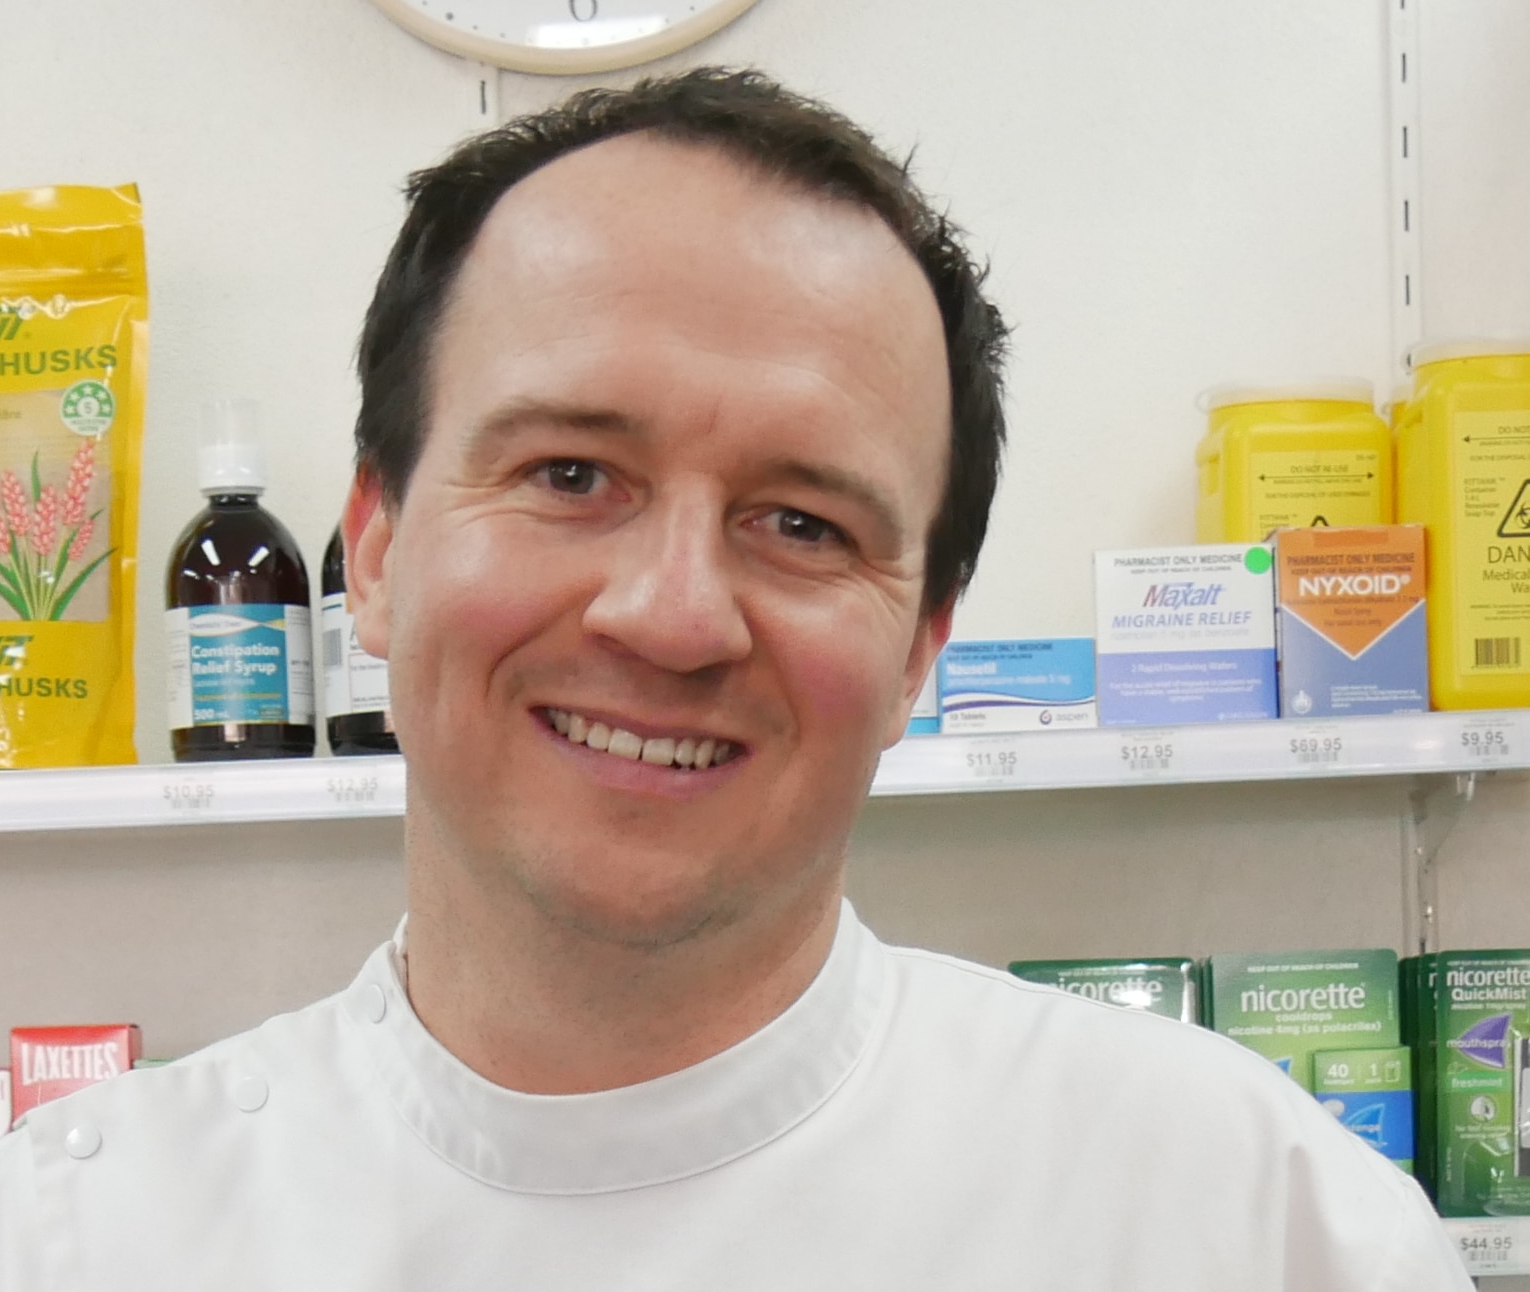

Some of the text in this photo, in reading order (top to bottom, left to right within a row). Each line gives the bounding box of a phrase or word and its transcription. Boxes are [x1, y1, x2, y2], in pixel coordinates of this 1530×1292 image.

[1114, 554, 1242, 567] PHARMACIST ONLY MEDICINE
[1287, 552, 1415, 566] PHARMACIST ONLY MEDICINE
[1483, 568, 1530, 582] Medical
[1298, 574, 1401, 597] NYXOID
[1143, 582, 1223, 610] Maxalt
[1112, 611, 1252, 629] MIGRAINE RELIEF
[191, 643, 280, 659] Constipation
[191, 660, 277, 676] Relief Syrup
[1290, 738, 1343, 754] $69.95
[1461, 731, 1504, 747] $9.95
[966, 752, 1018, 768] $11.95
[1121, 744, 1173, 760] $12.95
[1241, 982, 1366, 1013] nicorette
[1451, 987, 1527, 1002] QuickMist
[1275, 1011, 1332, 1023] cooldrops
[1228, 1024, 1272, 1037] nicotine
[1275, 1024, 1300, 1037] 4mg
[1322, 1020, 1382, 1034] polacrilex)
[21, 1041, 119, 1087] LAXETTES
[1327, 1064, 1349, 1078] 40
[1451, 1076, 1503, 1089] freshmint
[1460, 1237, 1512, 1252] $44.95
